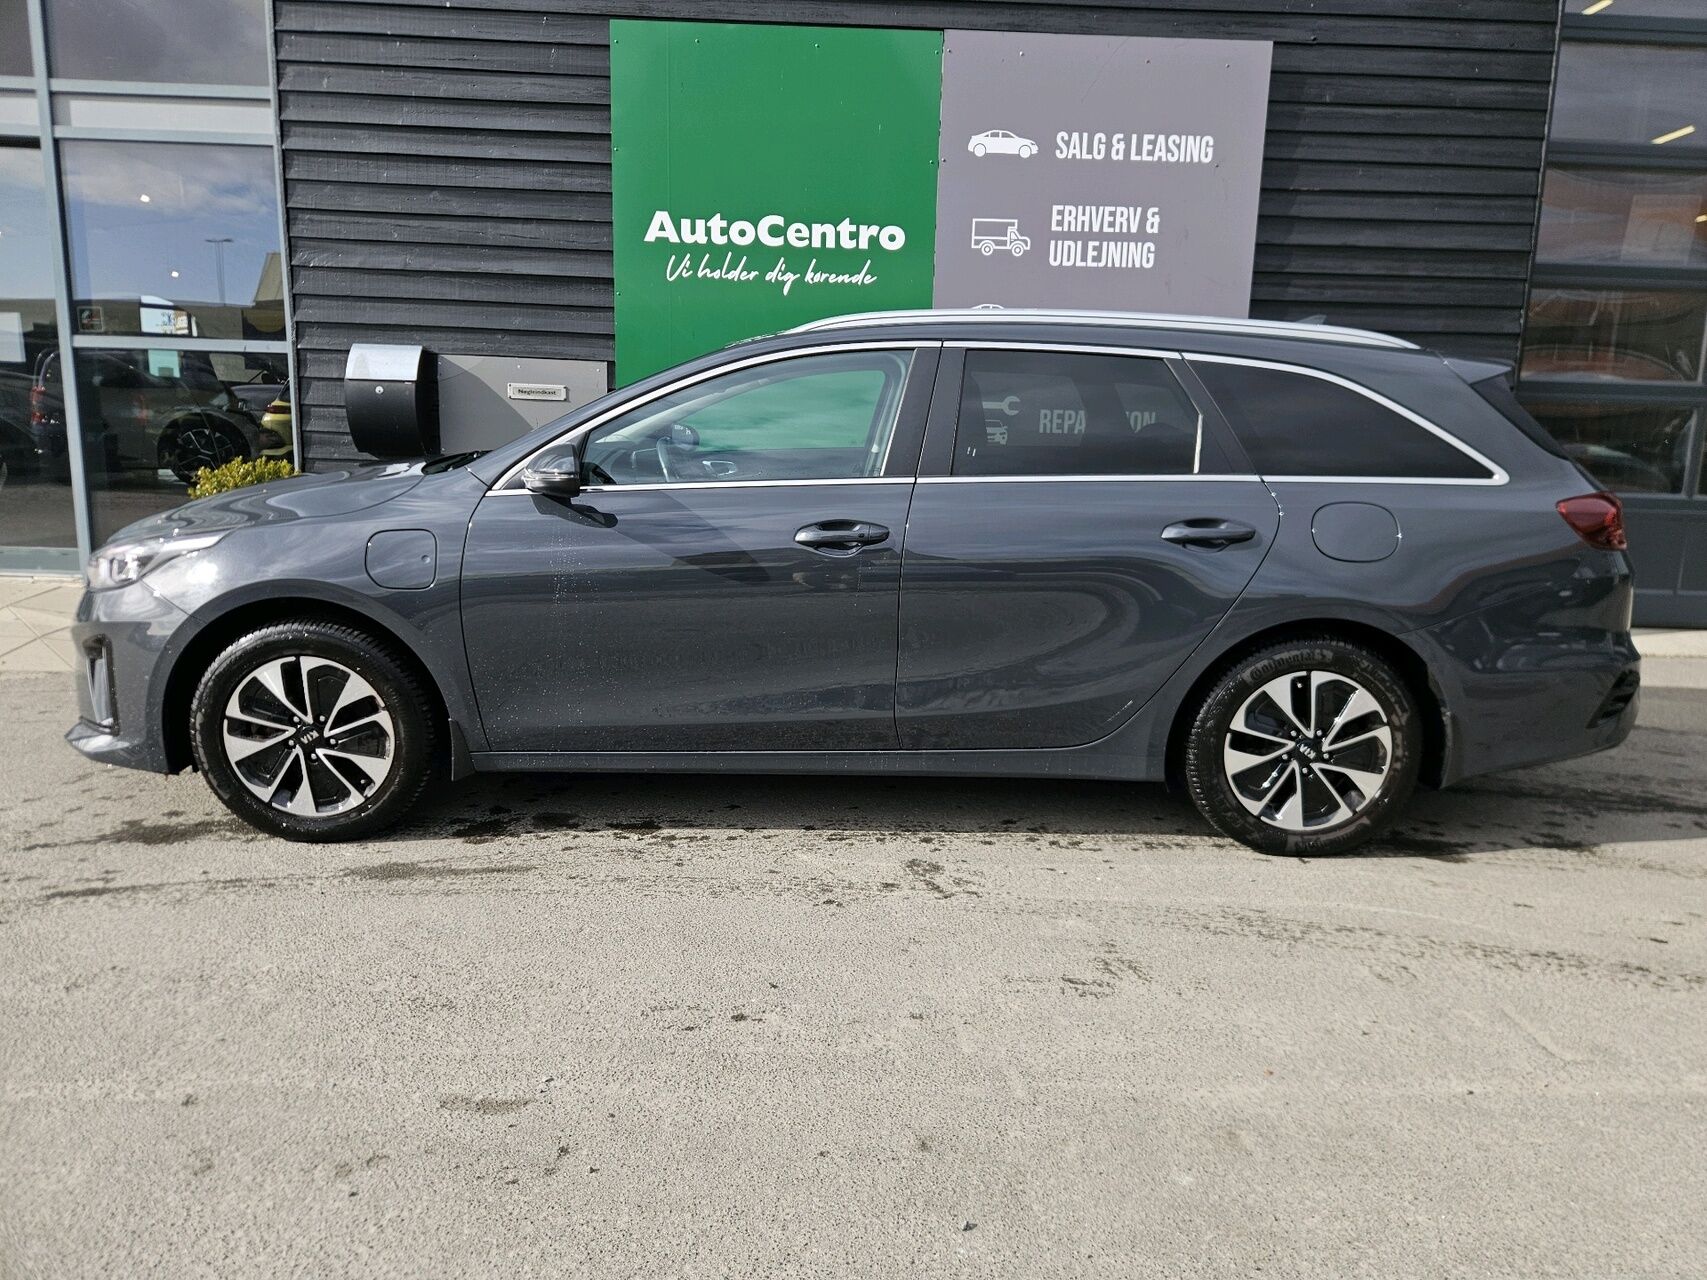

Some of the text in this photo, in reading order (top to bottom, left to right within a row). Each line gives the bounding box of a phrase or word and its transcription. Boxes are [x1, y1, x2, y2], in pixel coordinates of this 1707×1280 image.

[1055, 130, 1214, 164] SALG & LEASING
[643, 210, 906, 251] AutoCentro
[1051, 204, 1161, 234] ERHVERV &
[1048, 239, 1156, 269] UDLEJNING
[666, 252, 693, 282] Vi
[697, 251, 760, 282] holder
[764, 256, 801, 296] dig
